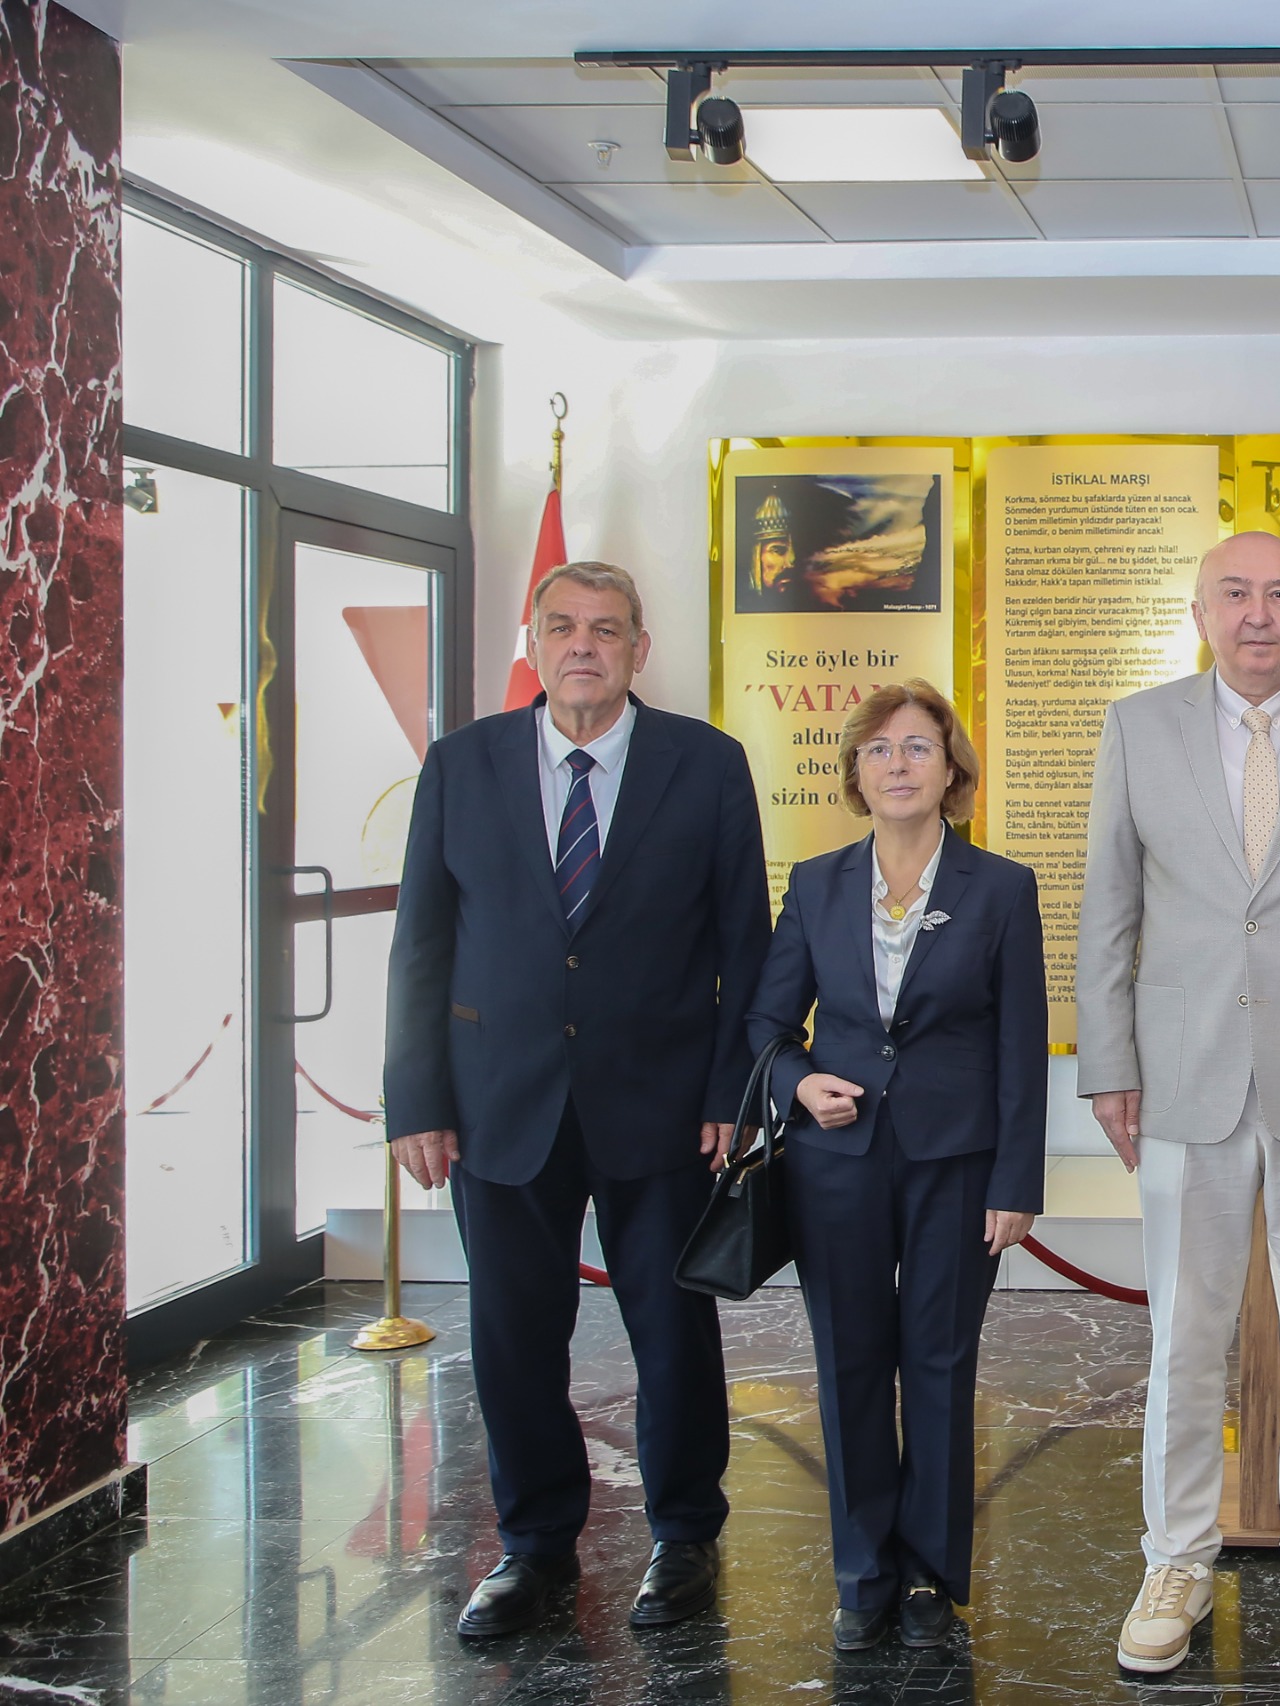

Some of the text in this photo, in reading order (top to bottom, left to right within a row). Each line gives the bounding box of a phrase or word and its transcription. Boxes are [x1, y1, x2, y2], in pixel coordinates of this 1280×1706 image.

[1052, 472, 1150, 487] İSTİKLAL MARŞI
[766, 650, 898, 672] Size öyle bir
[772, 788, 819, 805] sizin
